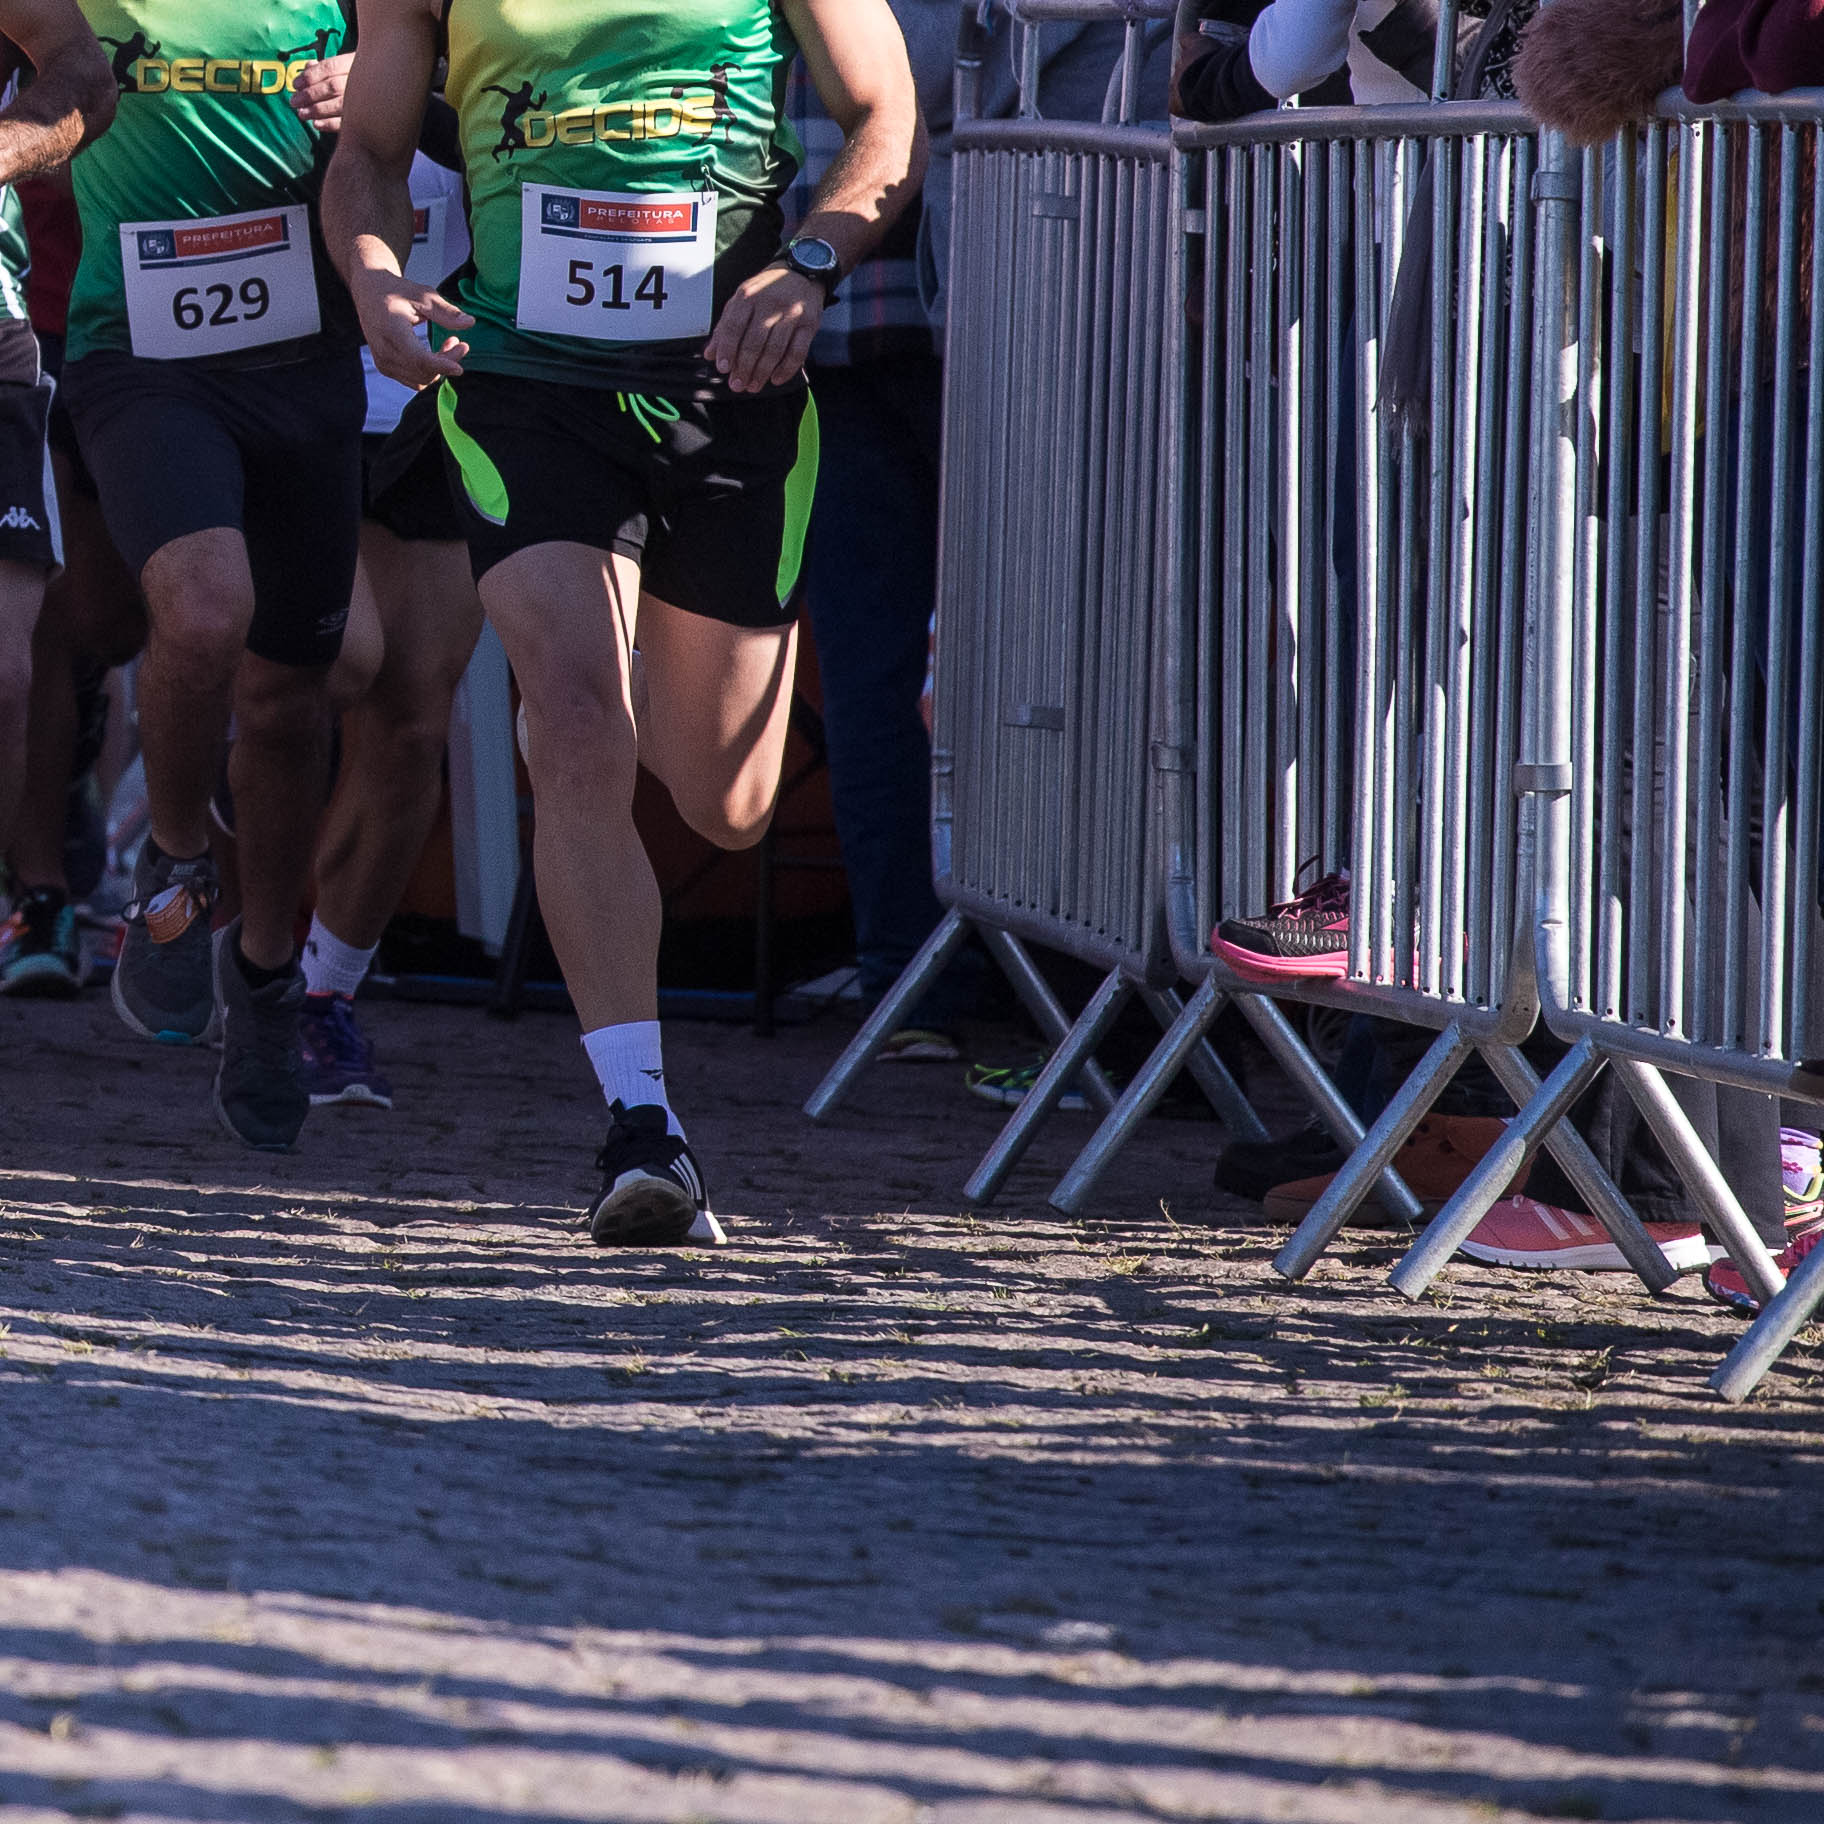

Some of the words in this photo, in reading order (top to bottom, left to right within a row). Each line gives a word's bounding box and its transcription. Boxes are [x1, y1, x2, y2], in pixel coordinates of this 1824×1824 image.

[523, 94, 717, 150] DECIDE
[181, 223, 274, 245] PREFEITURA
[587, 206, 685, 219] PREFEITURA
[171, 276, 271, 332] 629
[565, 258, 669, 311] 514
